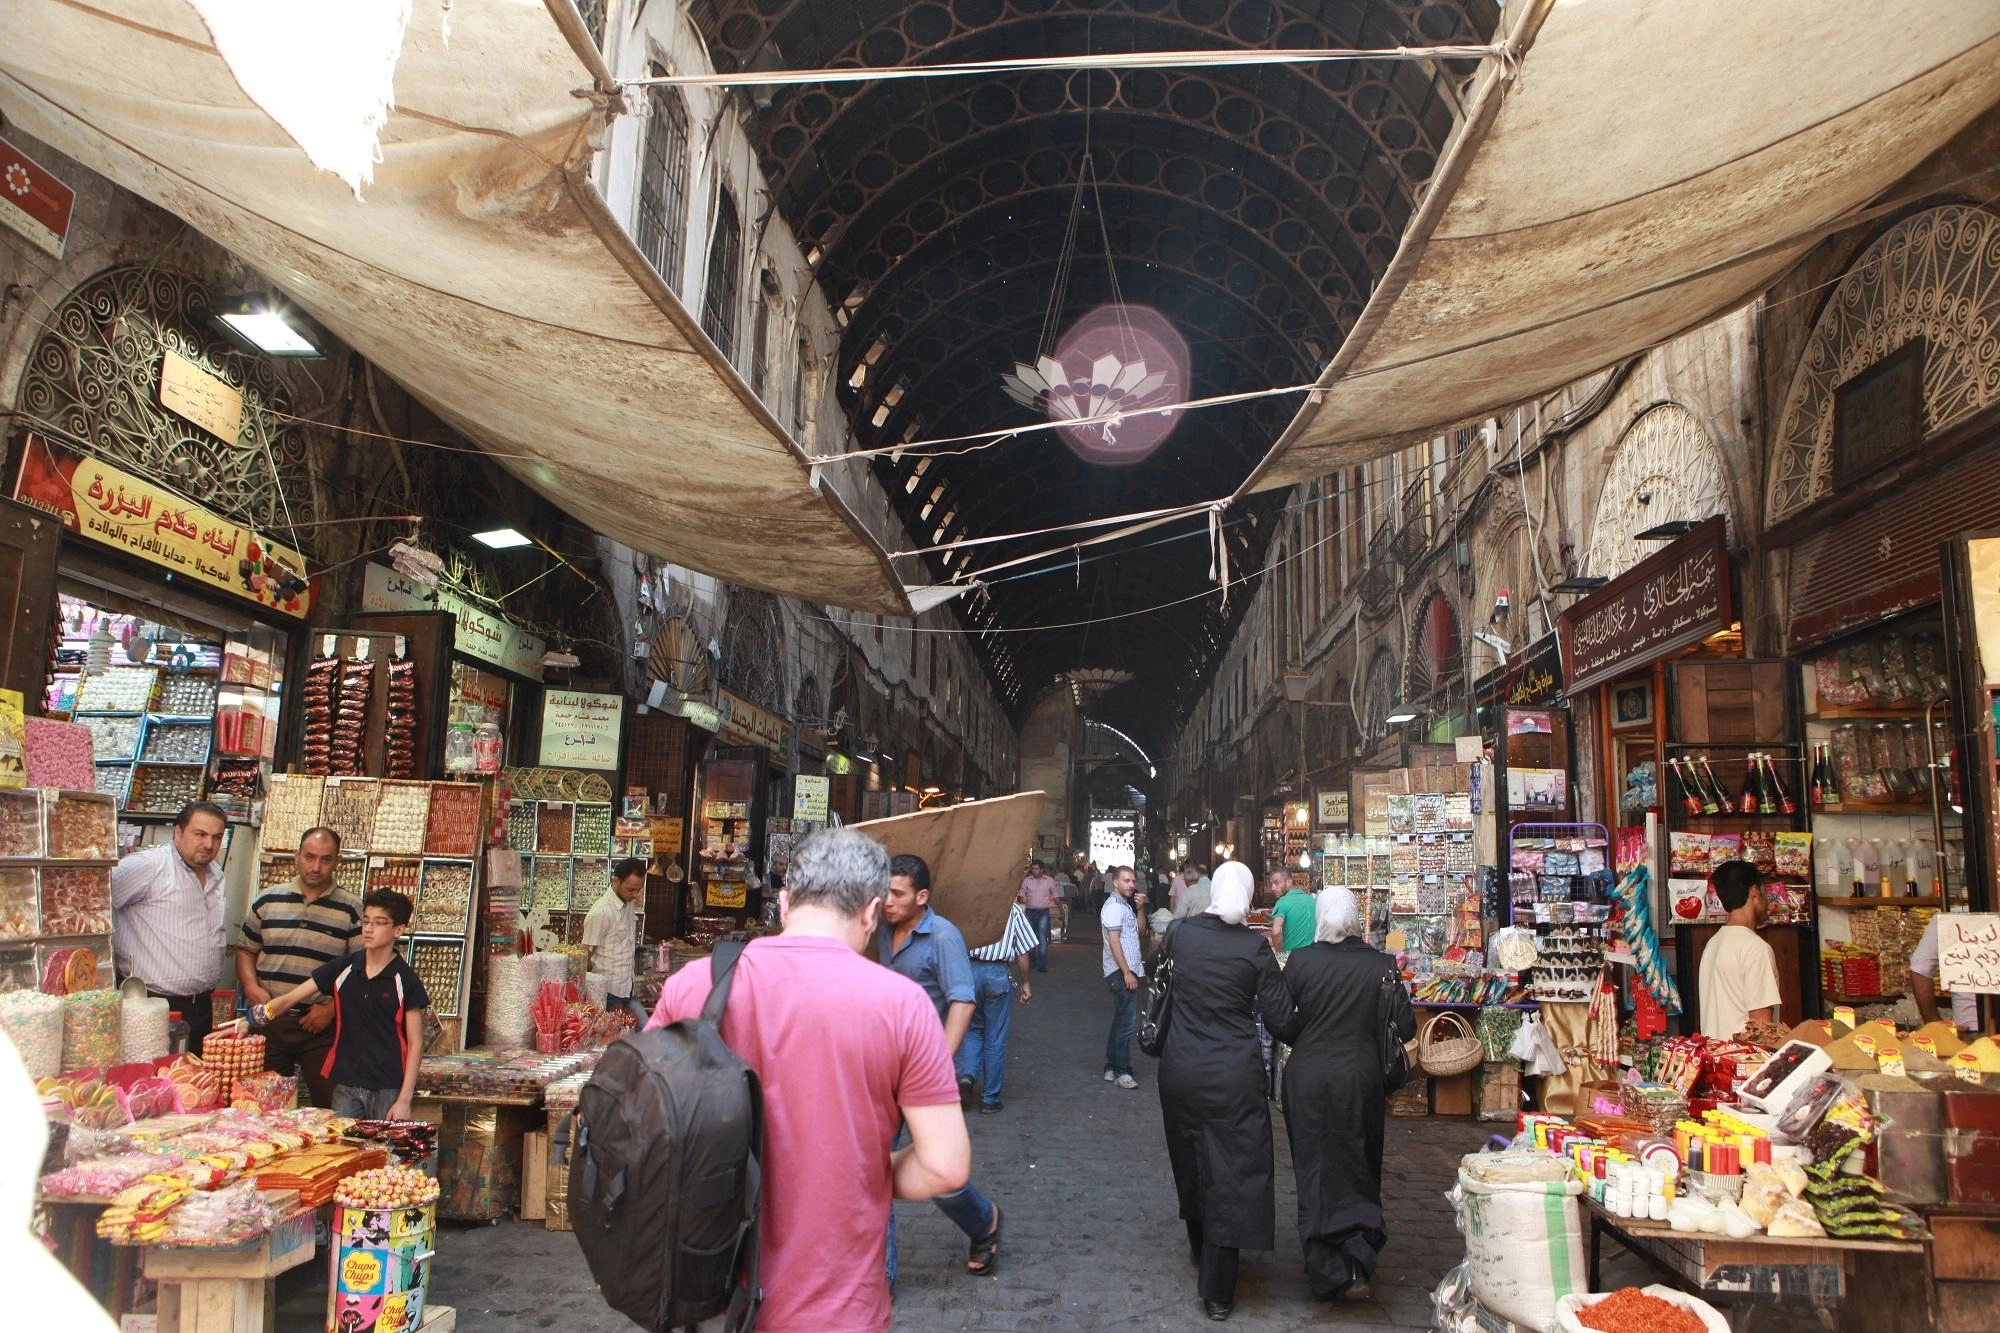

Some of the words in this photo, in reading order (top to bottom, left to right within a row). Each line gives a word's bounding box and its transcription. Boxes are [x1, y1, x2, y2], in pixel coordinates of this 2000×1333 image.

[195, 558, 231, 583] شوكولا
[580, 697, 619, 711] شوكولا
[346, 1259, 377, 1273] Chupa
[344, 1269, 374, 1285] Chups
